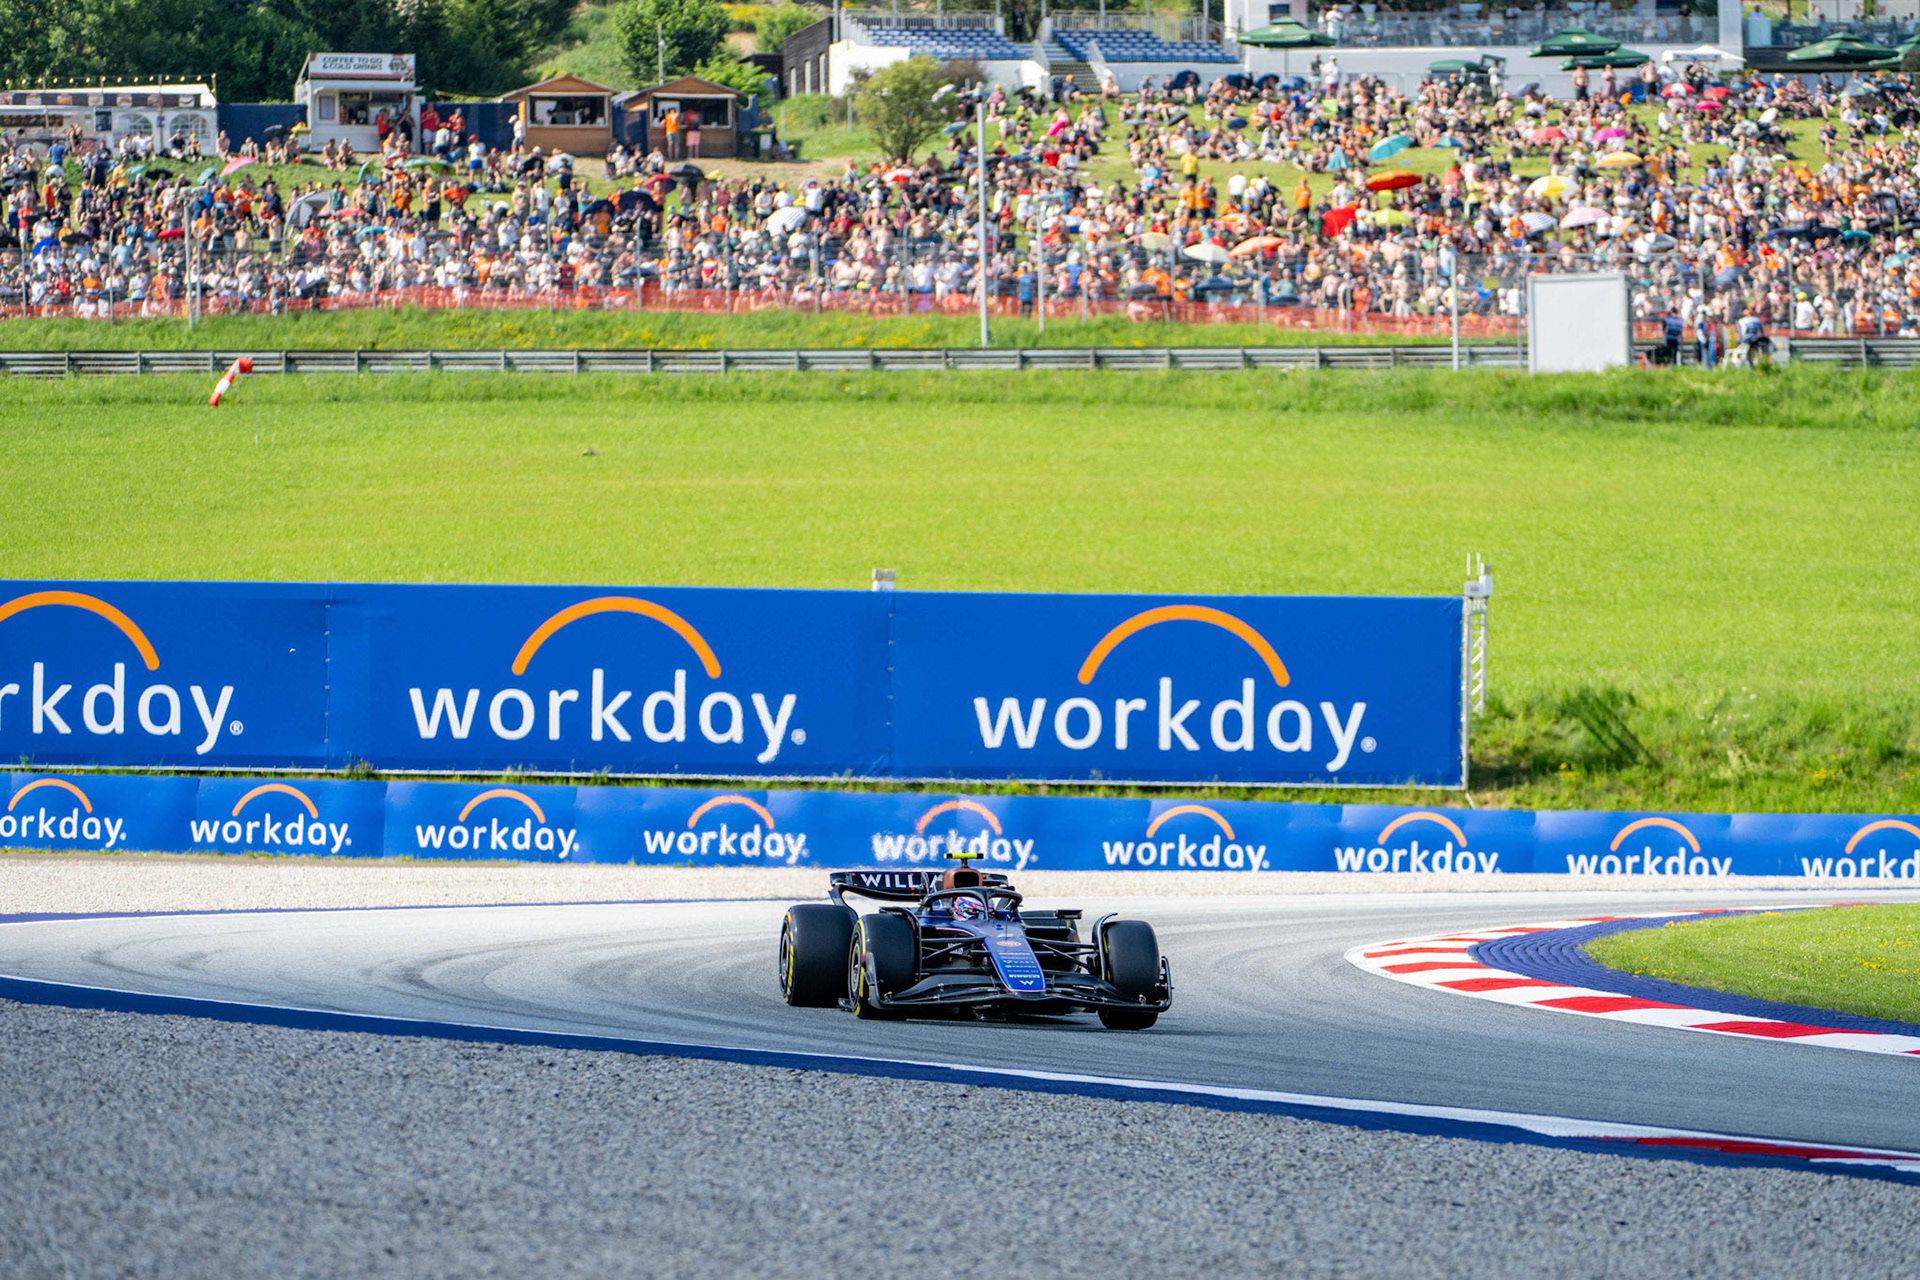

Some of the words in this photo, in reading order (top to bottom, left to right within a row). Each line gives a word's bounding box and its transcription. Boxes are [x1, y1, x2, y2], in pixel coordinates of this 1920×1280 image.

[357, 56, 369, 64] TO
[353, 63, 383, 71] DRINKS
[860, 873, 938, 890] WILL
